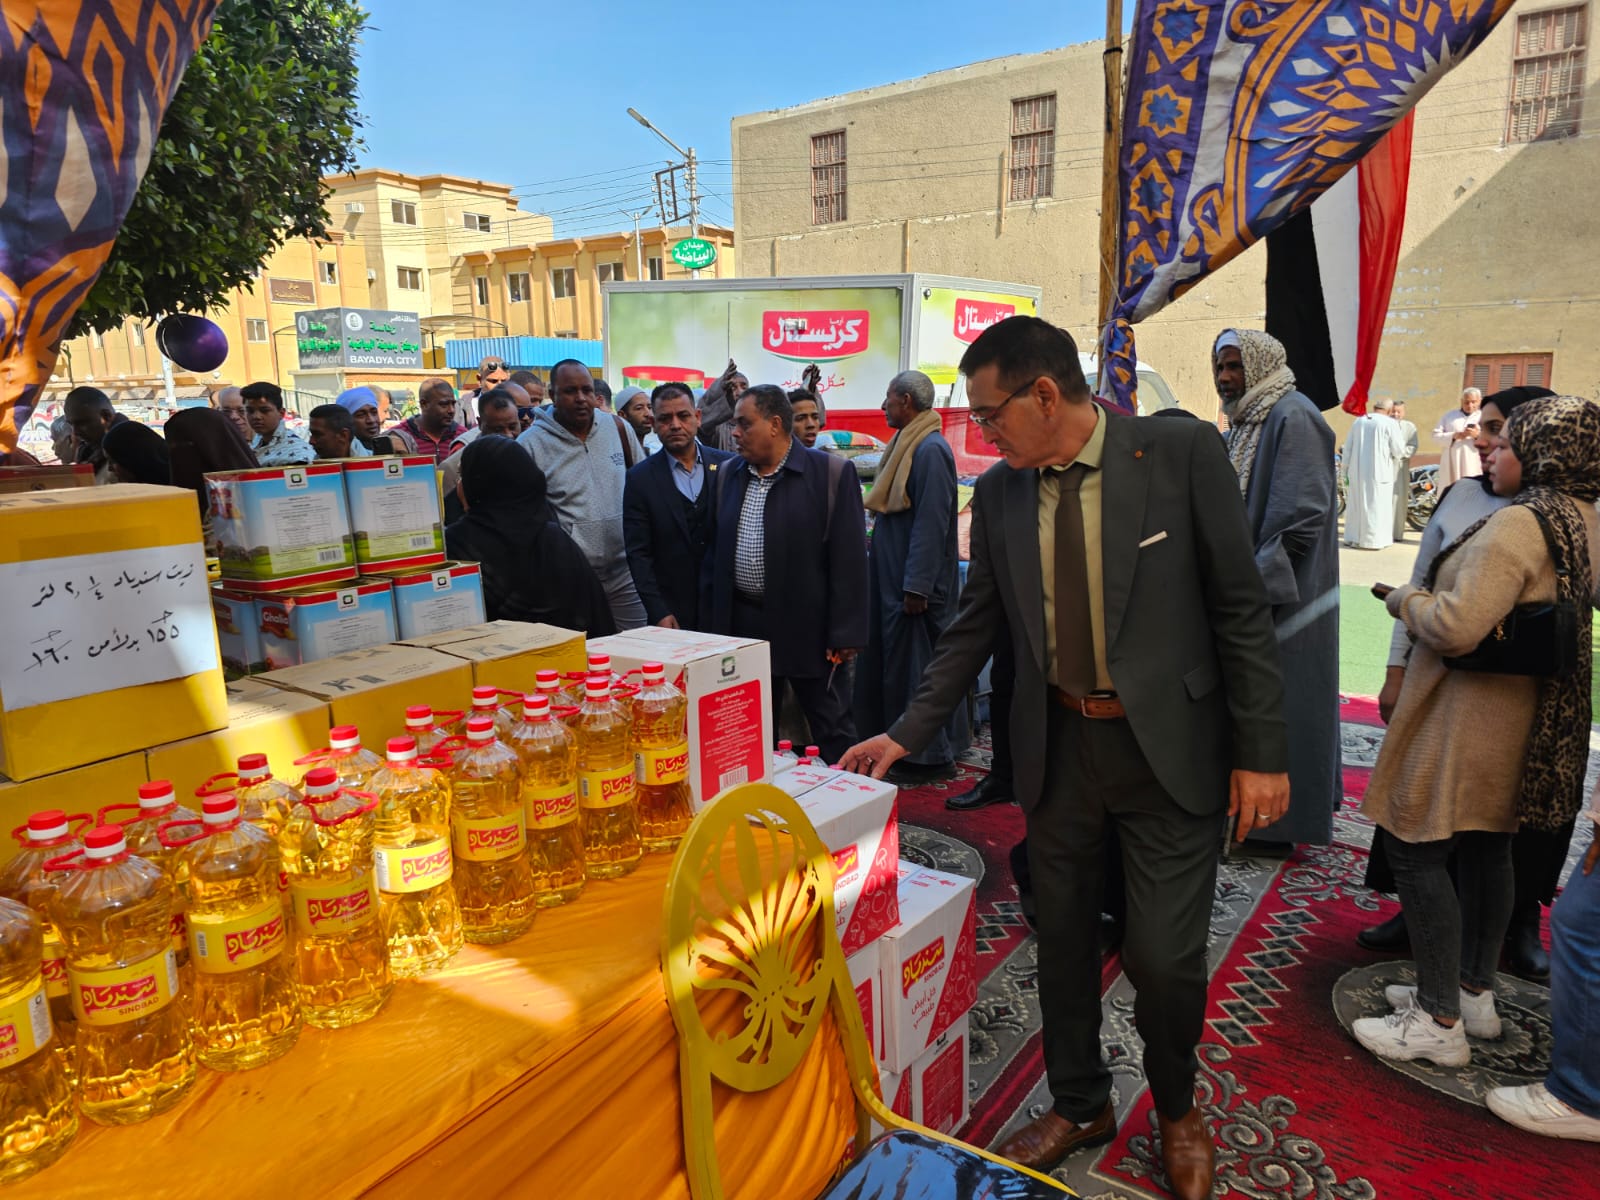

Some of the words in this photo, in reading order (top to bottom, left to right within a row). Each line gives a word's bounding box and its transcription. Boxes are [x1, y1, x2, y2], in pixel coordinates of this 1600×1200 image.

[674, 247, 713, 265] البياضية
[682, 241, 704, 251] ميدان
[349, 355, 394, 364] BAYADYA
[396, 356, 417, 365] CITY
[166, 563, 193, 588] زيت
[31, 582, 55, 608] لتر
[469, 828, 518, 849] سندباد
[402, 850, 450, 879] سندباد
[835, 872, 860, 892] INDBAD
[310, 892, 369, 920] سندباد
[228, 918, 283, 954] سندباد
[903, 942, 945, 989] سندباد
[82, 977, 155, 1009] سندباد
[119, 996, 160, 1015] SINDBAD
